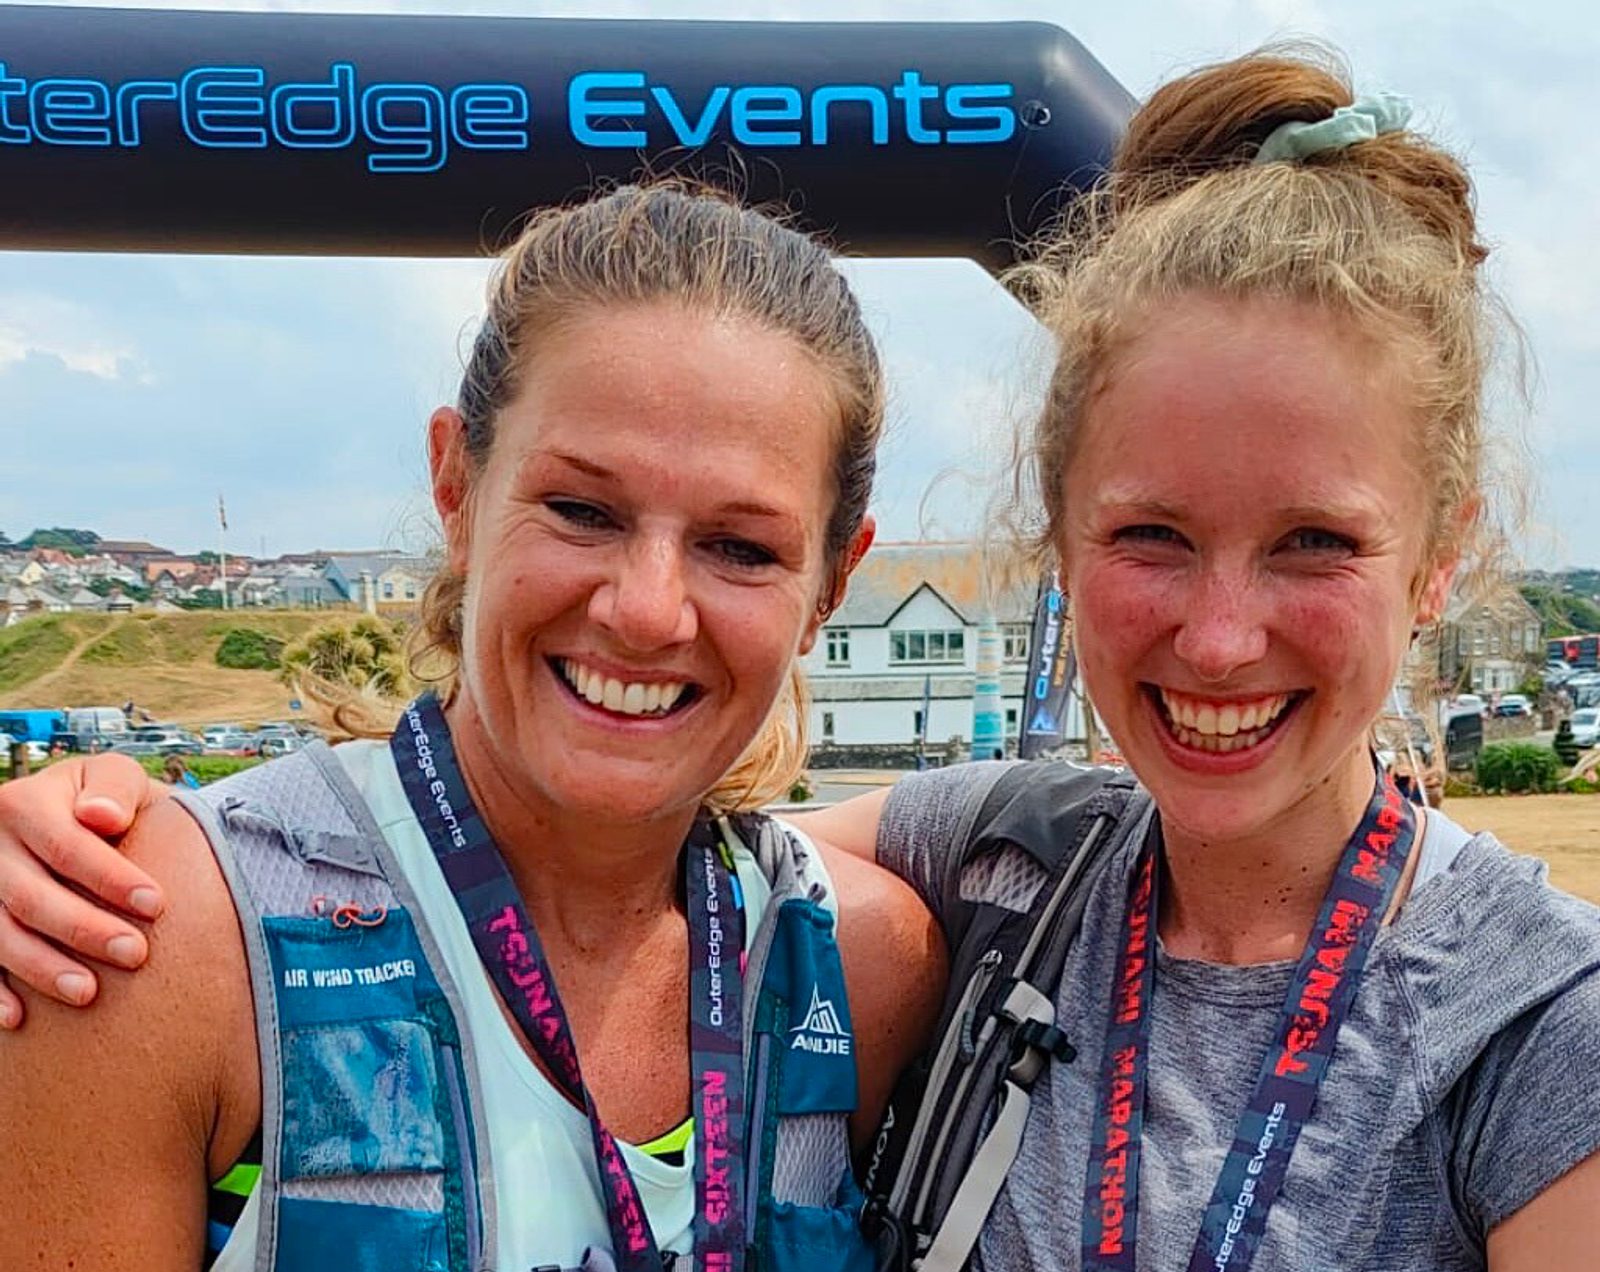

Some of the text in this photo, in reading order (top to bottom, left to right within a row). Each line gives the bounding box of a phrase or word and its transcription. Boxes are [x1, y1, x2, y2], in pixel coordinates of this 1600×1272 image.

[567, 71, 1016, 147] Events
[430, 780, 467, 848] Events
[284, 968, 308, 989] AIR
[312, 967, 354, 988] WIND
[709, 917, 724, 1026] OuterEdge
[1274, 898, 1369, 1077] TSUNAMI
[702, 1070, 728, 1225] SIXTEEN
[1098, 1045, 1137, 1255] MARATHON
[1246, 1101, 1286, 1175] Events
